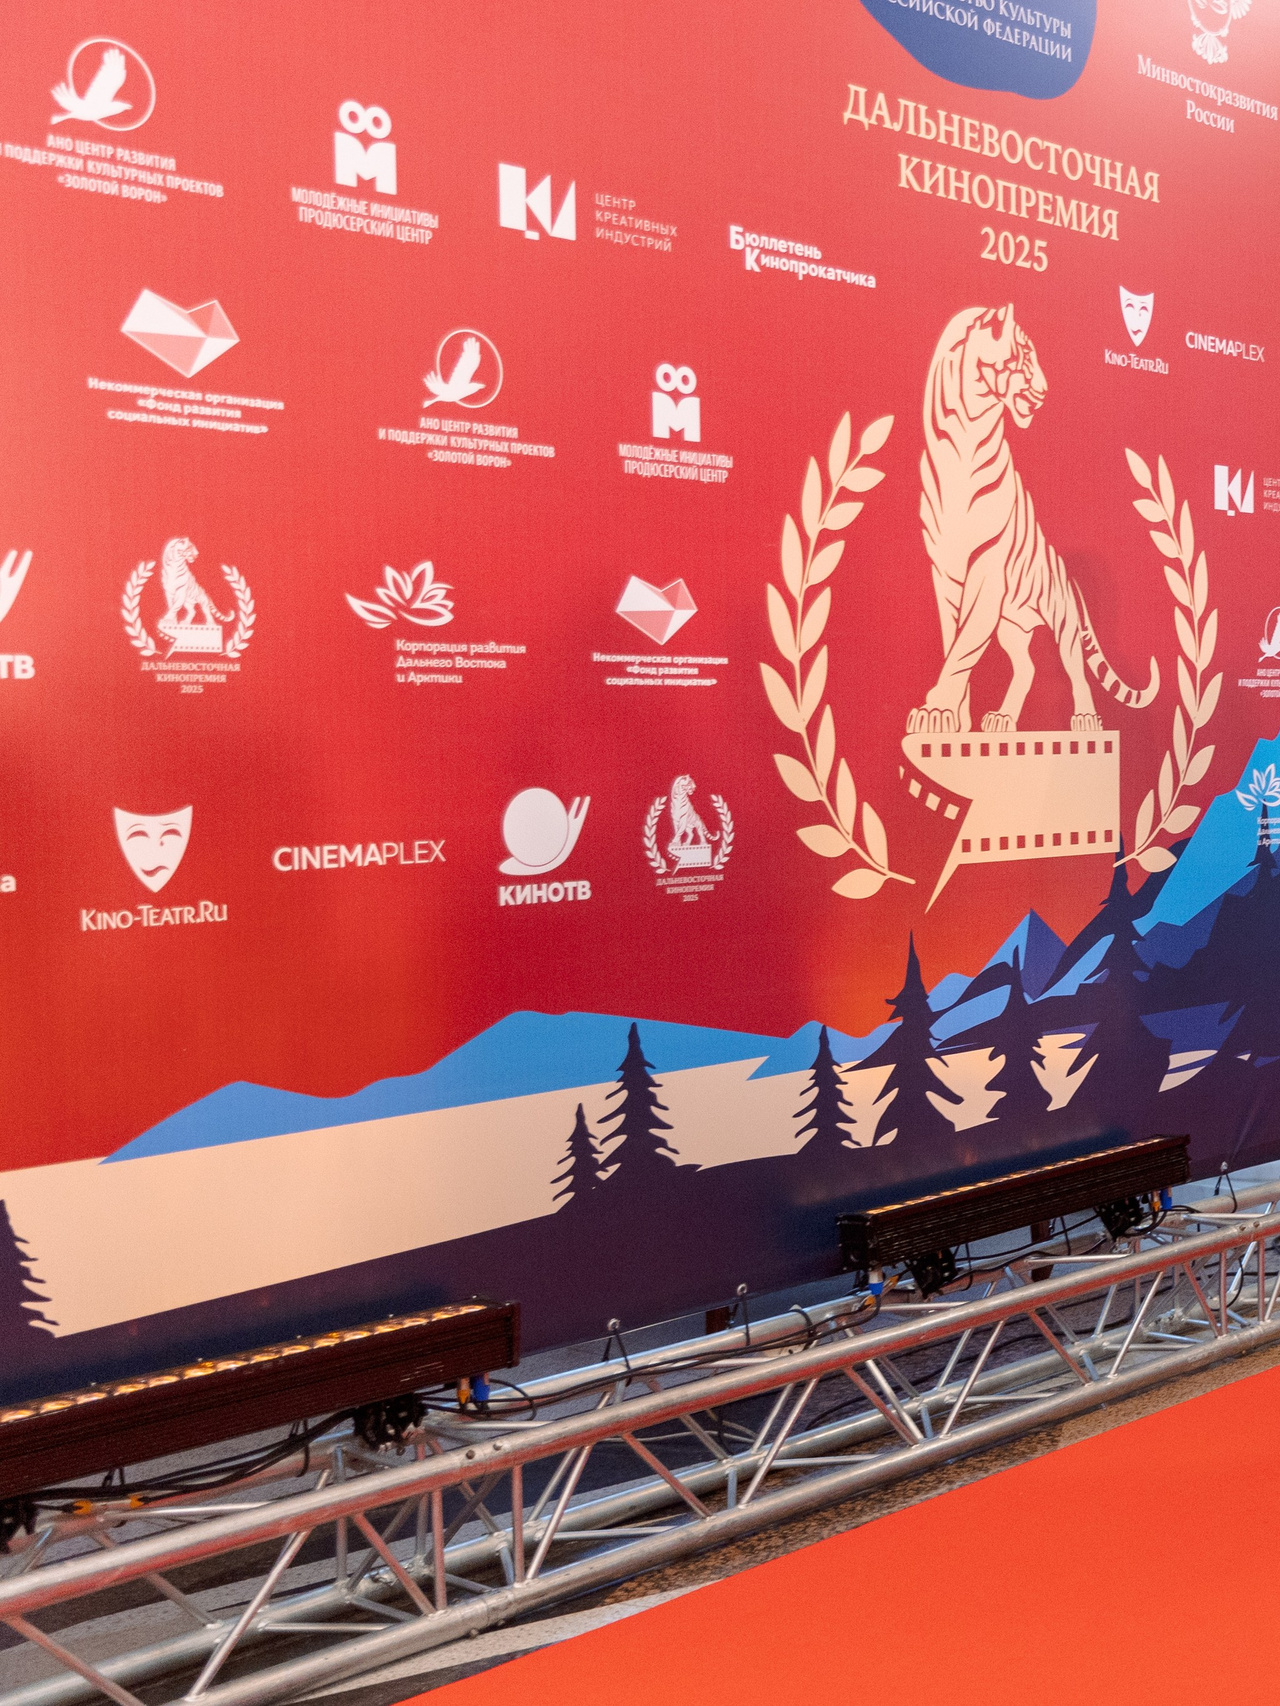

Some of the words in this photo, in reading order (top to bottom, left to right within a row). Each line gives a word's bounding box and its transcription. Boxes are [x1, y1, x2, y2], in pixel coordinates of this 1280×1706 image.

[1000, 0, 1072, 39] КУЛЬТУРЫ
[983, 18, 1072, 62] ФЕДЕРАЦИИ
[1137, 54, 1278, 121] Минвостокразвития
[1186, 99, 1235, 133] России
[47, 134, 73, 152] АНО
[75, 139, 114, 159] ЦЕНТР
[116, 147, 176, 171] РАЗВИТИЯ
[843, 84, 1160, 203] ДАЛЬНЕВОСТОЧНАЯ
[4, 143, 84, 171] ПОДДЕРЖКИ
[87, 160, 164, 187] КУЛЬТУРНЫХ
[166, 175, 224, 198] ПРОЕКТОВ
[58, 173, 119, 196] «ЗОЛОТОЙ
[121, 184, 168, 204] ВОРОН»
[595, 193, 636, 211] ЦЕНТР
[898, 153, 1120, 241] КИНОПРЕМИЯ
[291, 187, 369, 215] МОЛОДЁЖНЫЕ
[370, 202, 439, 229] ИНИЦИАТИВЫ
[595, 210, 678, 237] КРЕАТИВНЫХ
[299, 206, 394, 239] ПРОДЮСЕРСКИЙ
[396, 225, 433, 245] ЦЕНТР
[595, 227, 672, 252] ИНДУСТРИЙ
[729, 225, 822, 260] Бюллетень
[980, 226, 1048, 272] 2025
[745, 247, 876, 289] Кинопрокатчика
[1185, 331, 1265, 363] CINEMAPLEX
[88, 377, 203, 401] Некоммерческая
[205, 393, 284, 410] организация
[107, 409, 190, 427] социальных
[183, 405, 242, 419] развития
[378, 428, 387, 440] И
[388, 429, 448, 446] ПОДДЕРЖКИ
[450, 437, 509, 453] КУЛЬТУРНЫХ
[511, 443, 556, 458] ПРОЕКТОВ
[419, 417, 440, 430] АНО
[441, 419, 471, 434] ЦЕНТР
[472, 423, 518, 439] РАЗВИТИЯ
[618, 443, 678, 463] МОЛОДЁЖНЫЕ
[680, 451, 733, 469] ИНИЦИАТИВЫ
[624, 460, 698, 480] ПРОДЮСЕРСКИЙ
[700, 469, 728, 484] ЦЕНТР
[396, 639, 467, 655] Корпорация
[470, 641, 526, 656] развития
[396, 655, 453, 668] Дальнего
[455, 656, 507, 669] Востока
[140, 661, 241, 672] ДАЛЬНЕВОСТОЧНАЯ
[156, 673, 227, 683] КИНОПРЕМИЯ
[396, 673, 405, 683] и
[407, 671, 463, 686] Арктики
[180, 684, 204, 694] 2025
[272, 840, 447, 873] CINEMAPLEX
[498, 880, 592, 907] КИНОТВ
